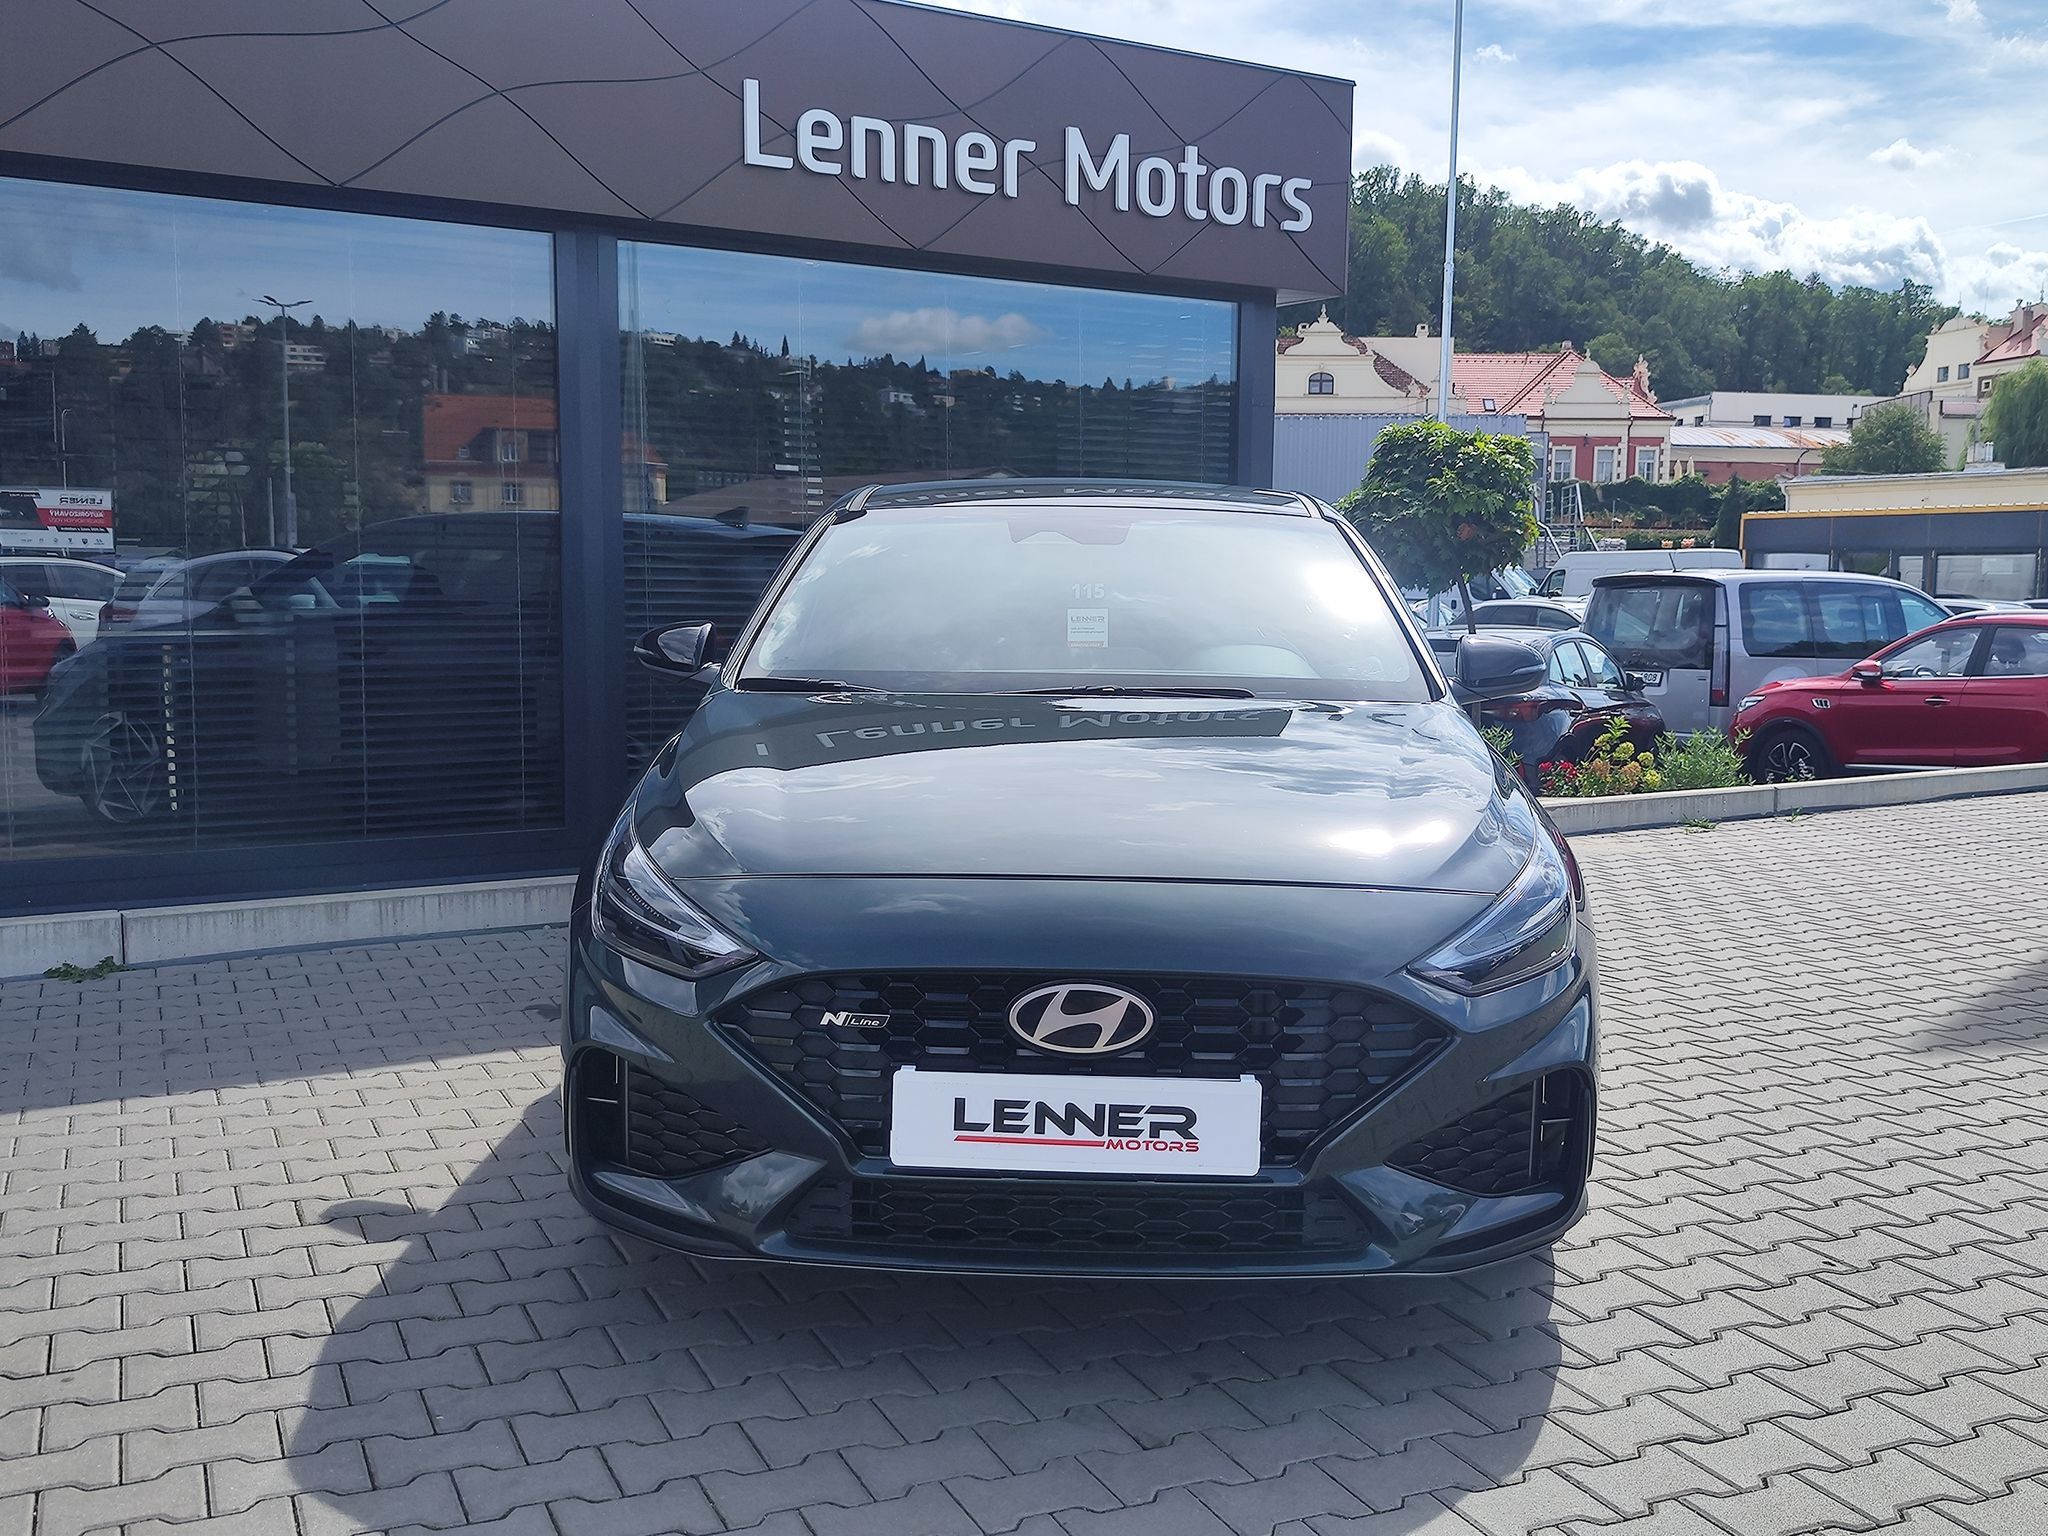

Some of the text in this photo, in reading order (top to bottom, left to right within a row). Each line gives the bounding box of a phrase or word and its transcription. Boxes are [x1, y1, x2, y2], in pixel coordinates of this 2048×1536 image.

[743, 78, 1314, 232] Lenner Motors
[1071, 583, 1105, 600] 115
[820, 1011, 880, 1027] N Line
[953, 1097, 1199, 1140] LENNER
[1105, 1138, 1200, 1153] MOTORS
